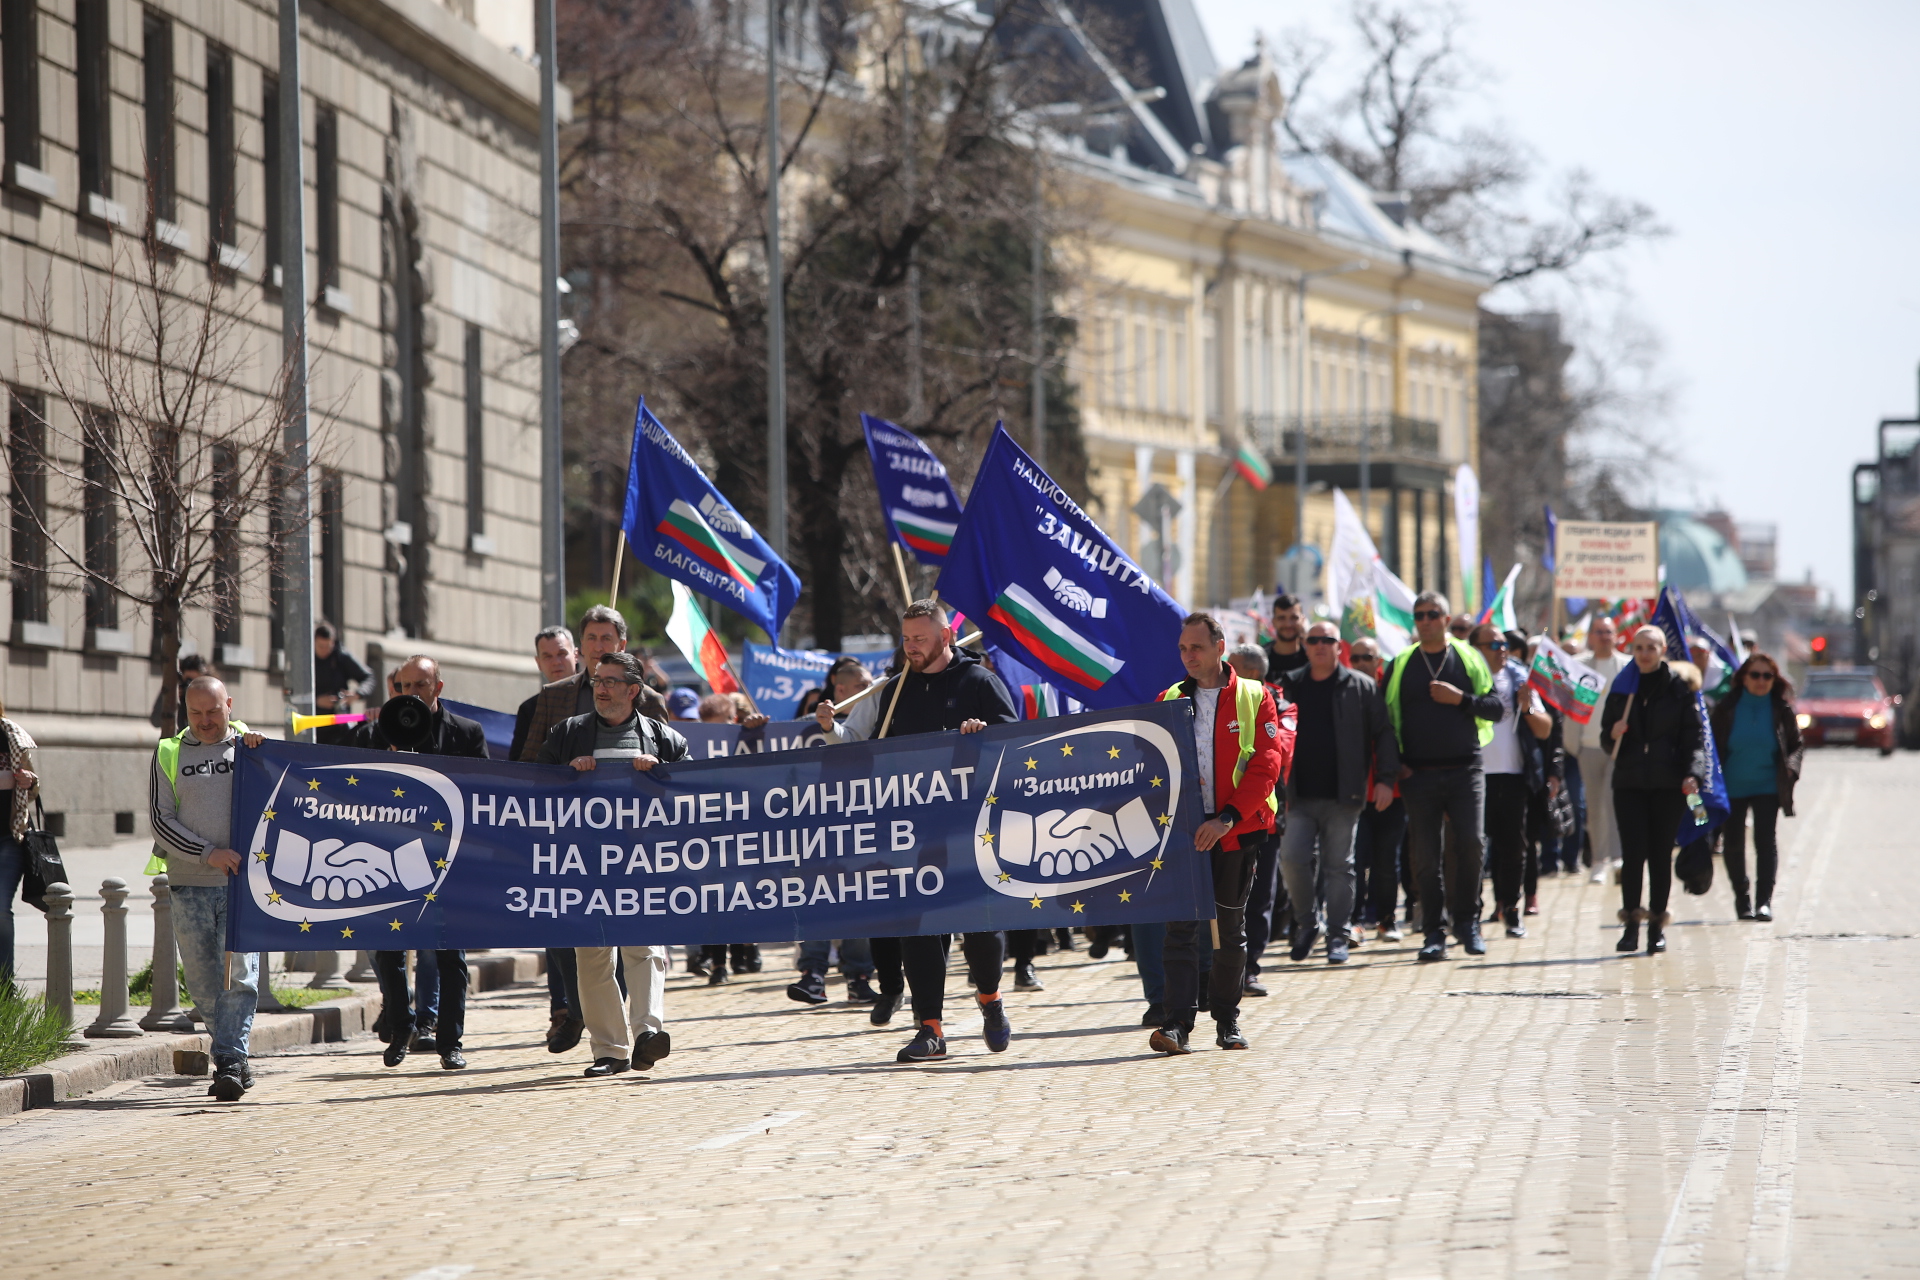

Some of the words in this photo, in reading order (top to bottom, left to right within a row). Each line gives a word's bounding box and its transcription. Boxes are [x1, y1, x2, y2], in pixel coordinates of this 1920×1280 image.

[654, 543, 746, 603] БЛАГОЕВГРАД
[472, 791, 750, 834] НАЦИОНАЛЕН
[763, 766, 974, 818] СИНДИКАТ
[1013, 762, 1145, 797] "Защита"
[293, 796, 428, 826] "Защита"
[532, 843, 588, 875] НА
[600, 822, 877, 876] РАБОТЕЩИТЕ
[890, 819, 916, 852] В
[505, 864, 945, 918] ЗДРАВЕОПАЗВАНЕТО
